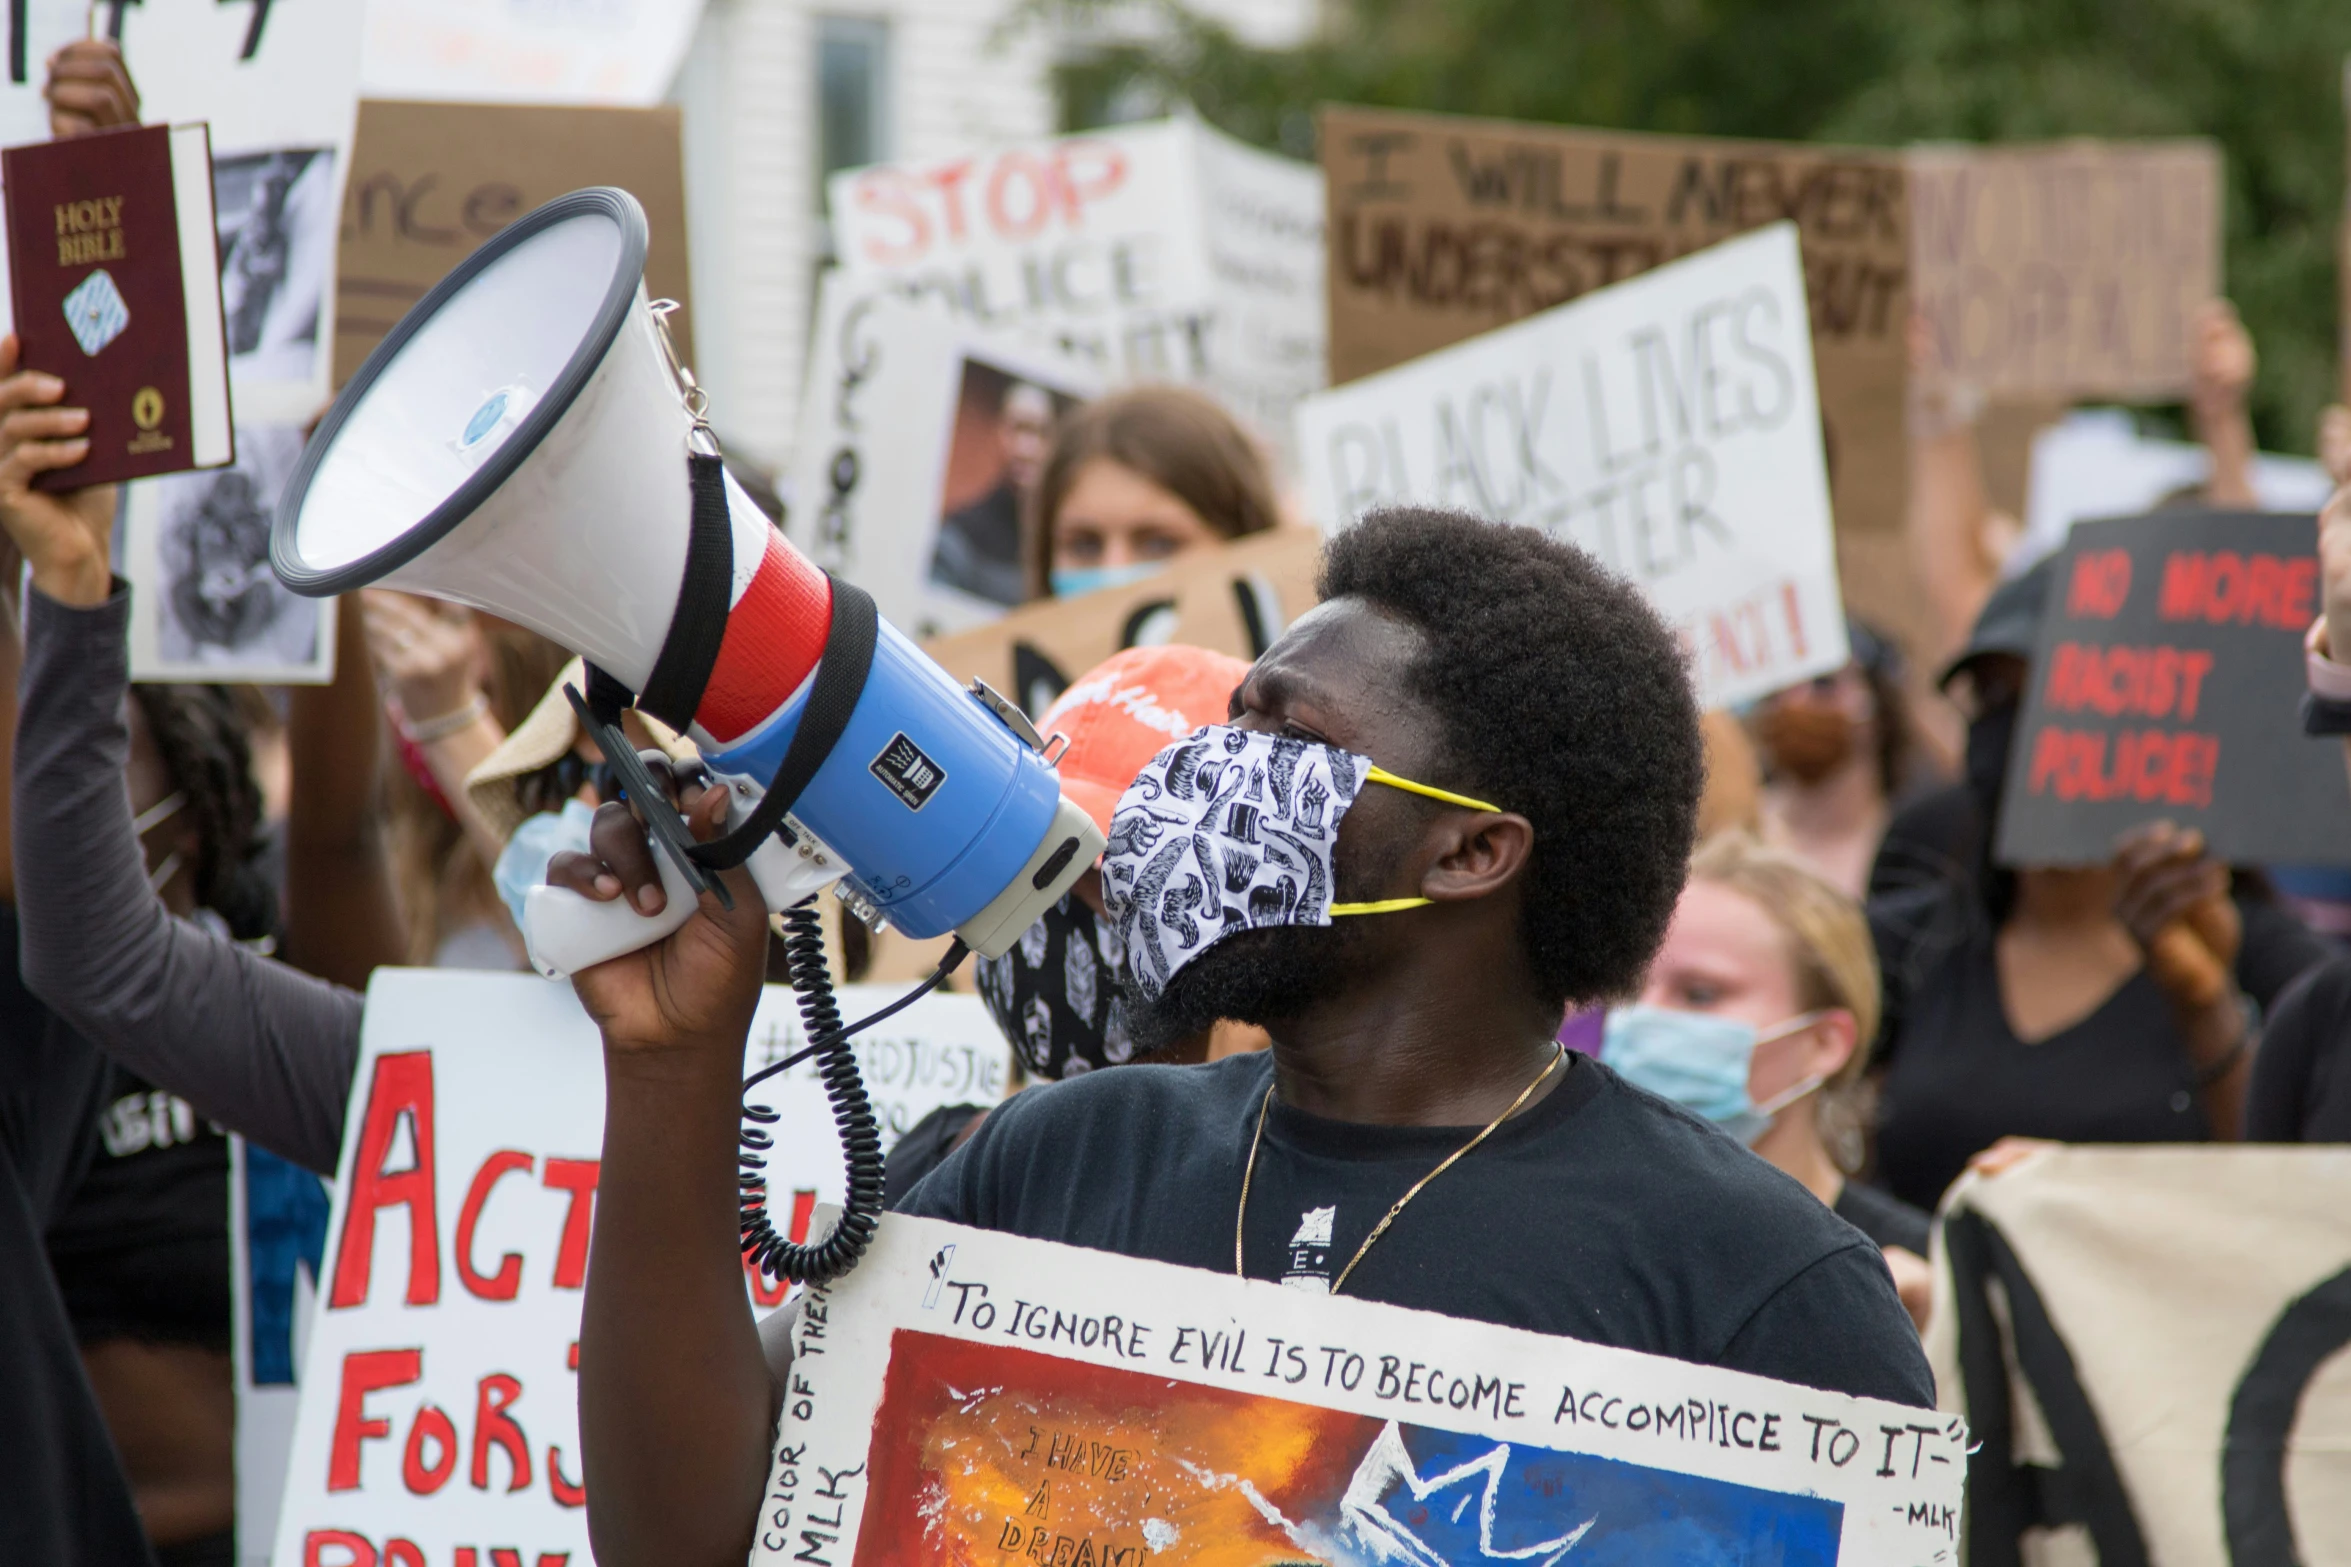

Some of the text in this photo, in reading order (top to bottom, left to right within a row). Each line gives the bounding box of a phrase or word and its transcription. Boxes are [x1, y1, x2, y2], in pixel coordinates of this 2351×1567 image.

[54, 195, 124, 235] HOLY
[341, 168, 528, 248] nce
[853, 138, 1131, 268] STOP
[1346, 132, 1420, 200] I
[1446, 138, 1646, 226] WILL
[1668, 158, 1903, 243] NEVER
[58, 228, 126, 266] BIBLE
[1582, 284, 1797, 474] LIVES
[2066, 546, 2320, 631] NO MORE
[2044, 641, 2214, 723] RACIST
[875, 764, 920, 806] AUTOMATIC SIREN
[2027, 725, 2221, 810] POLICE!
[789, 819, 817, 845] OFF TALK
[1004, 1300, 1152, 1358] IGNORE
[1264, 1338, 1308, 1384] IS
[1320, 1347, 1365, 1391] TO
[1374, 1355, 1526, 1421] BECOME
[1802, 1413, 1860, 1468] TO
[763, 1441, 807, 1552] COLOR
[792, 1373, 815, 1421] OF
[1020, 1425, 1132, 1481] I HAVE
[1024, 1479, 1051, 1520] A
